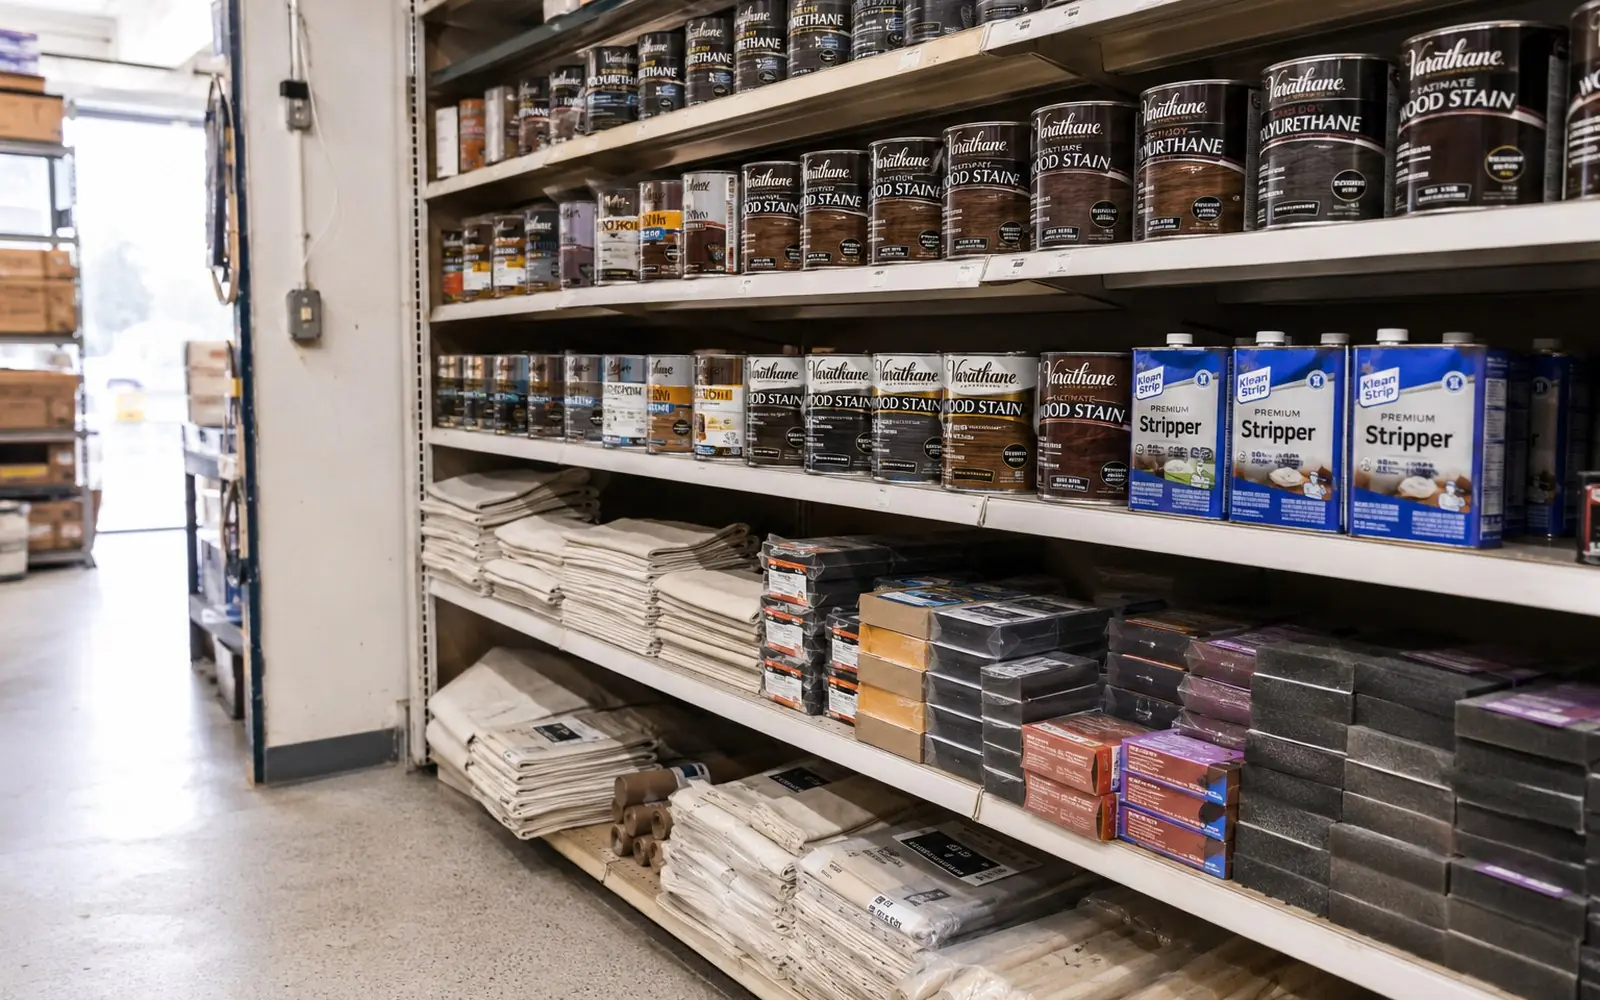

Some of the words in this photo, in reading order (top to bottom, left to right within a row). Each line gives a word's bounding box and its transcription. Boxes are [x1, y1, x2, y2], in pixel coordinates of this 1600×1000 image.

[1408, 38, 1503, 81] Varathane
[1267, 66, 1344, 103] Varathane
[1448, 88, 1517, 109] STAIN
[1142, 92, 1206, 126] Varathane
[1035, 112, 1101, 143] Varathane
[948, 131, 1007, 156] Varathane
[1062, 152, 1112, 170] STAIN
[943, 170, 969, 190] OOD
[763, 200, 800, 215] STAIN
[808, 359, 869, 382] Varathane
[875, 358, 940, 383] Varathane
[946, 359, 1018, 385] Varathane
[1043, 359, 1117, 388] Varathane
[1137, 371, 1163, 386] Klean
[1138, 382, 1161, 395] Strip
[1239, 374, 1268, 388] Klean
[1362, 374, 1397, 392] Klean
[768, 393, 802, 406] STAIN
[1241, 384, 1266, 398] Strip
[1365, 386, 1395, 401] Strip
[835, 395, 872, 409] STAIN
[901, 397, 941, 412] STAIN
[948, 399, 975, 413] OOD
[978, 400, 1023, 416] STAIN
[1150, 404, 1189, 414] PREMIUM
[1074, 403, 1126, 423] STAIN
[1254, 408, 1301, 418] PREMIUM
[1380, 412, 1436, 423] PREMIUM
[1139, 415, 1202, 439] Stripper
[1241, 419, 1316, 445] Stripper
[1365, 425, 1453, 453] Stripper
